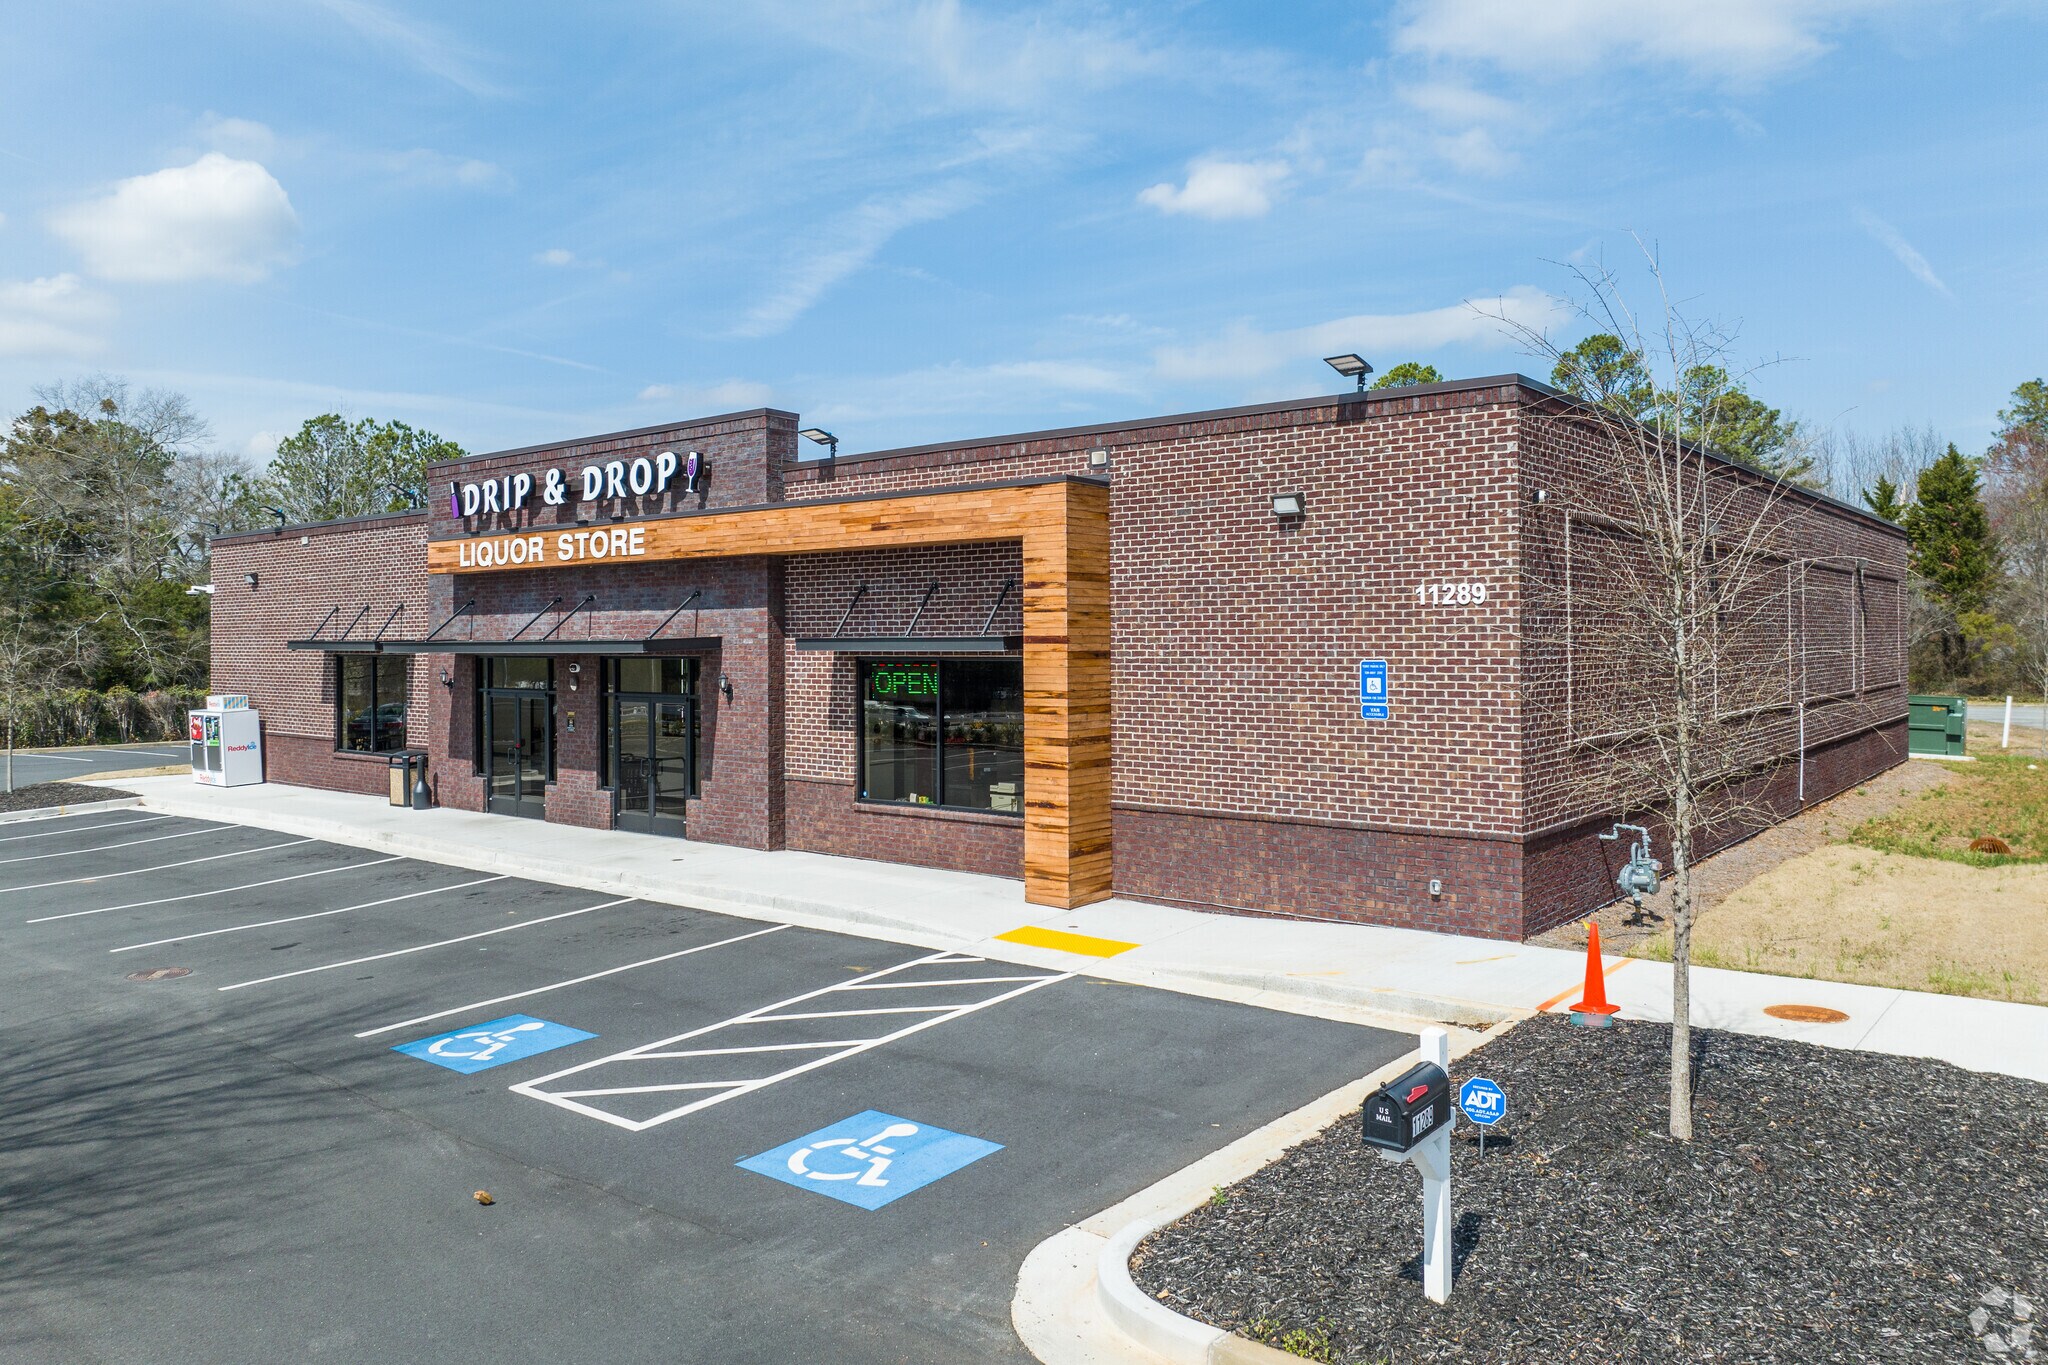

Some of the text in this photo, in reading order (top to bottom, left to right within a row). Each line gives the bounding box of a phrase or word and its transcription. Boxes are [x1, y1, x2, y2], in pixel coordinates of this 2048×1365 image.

[462, 451, 678, 516] DRIP & DROP
[459, 528, 645, 567] LIQUOR STORE
[1415, 583, 1486, 605] 11289
[875, 672, 938, 695] OPEN
[1464, 1090, 1502, 1111] ADT
[1375, 1113, 1393, 1123] MAIL
